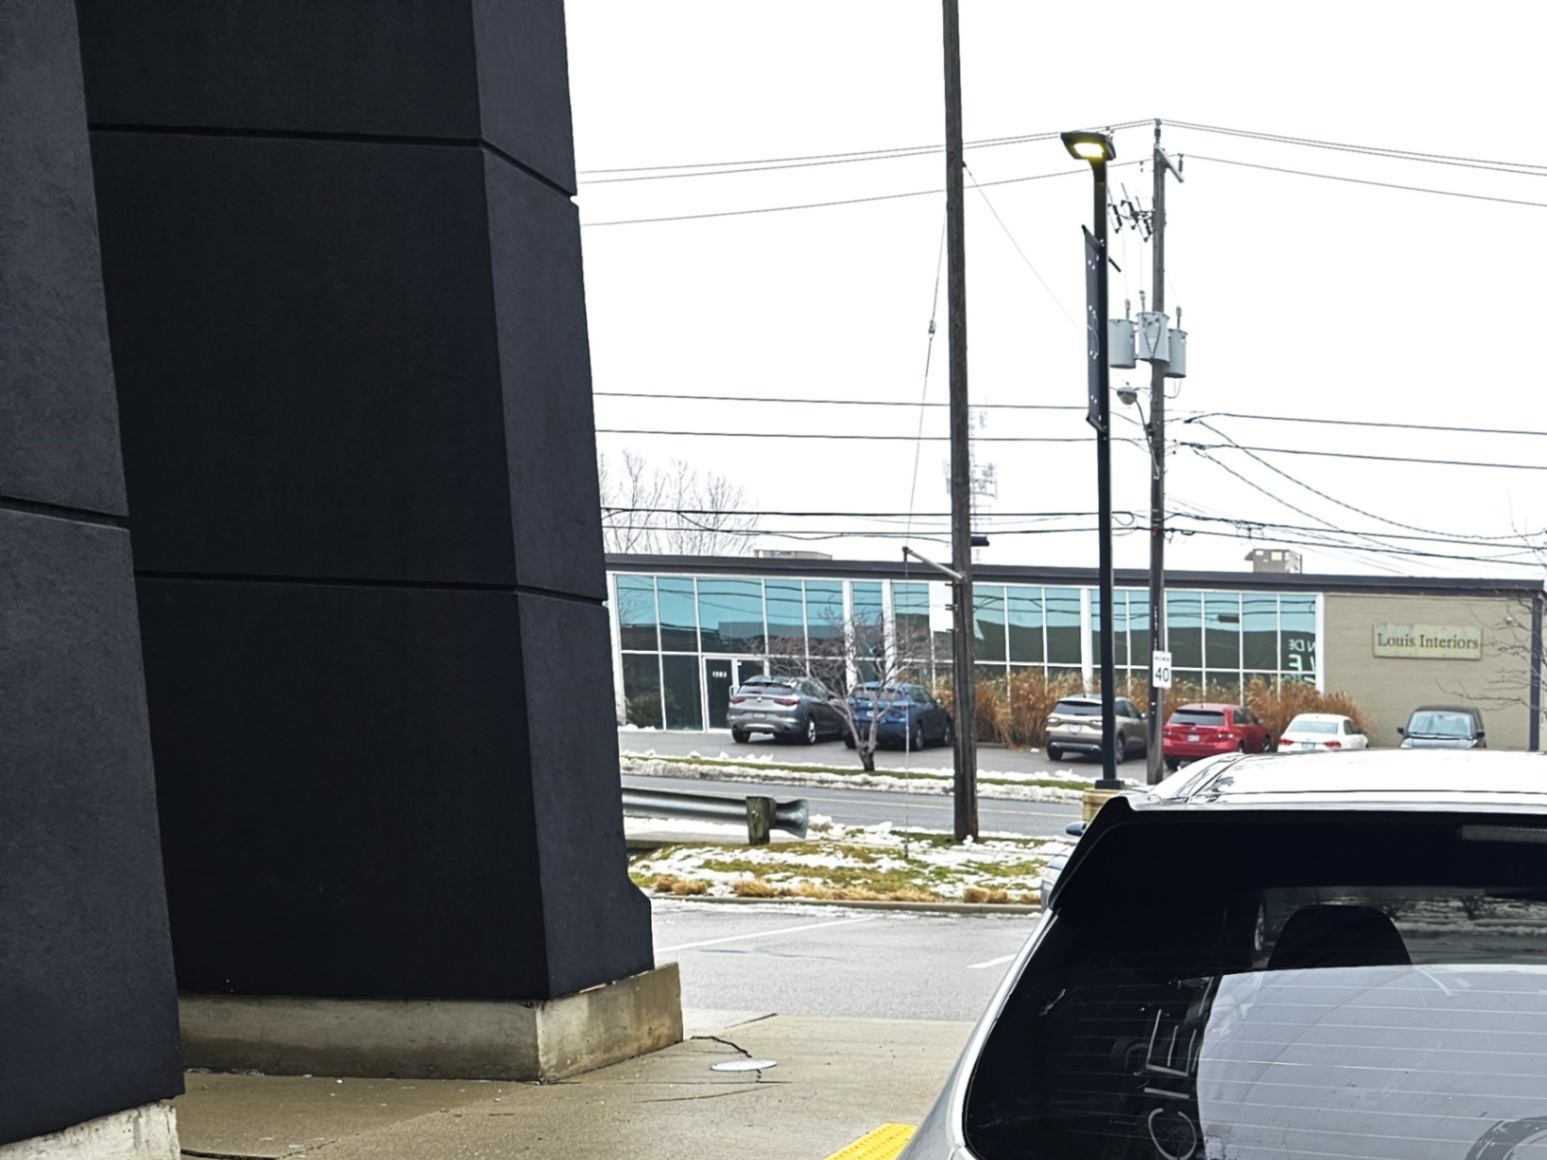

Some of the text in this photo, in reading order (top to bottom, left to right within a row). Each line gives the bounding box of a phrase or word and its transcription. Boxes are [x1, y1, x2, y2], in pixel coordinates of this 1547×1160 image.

[1377, 633, 1479, 649] Louis Interiors
[1155, 667, 1169, 682] 40
